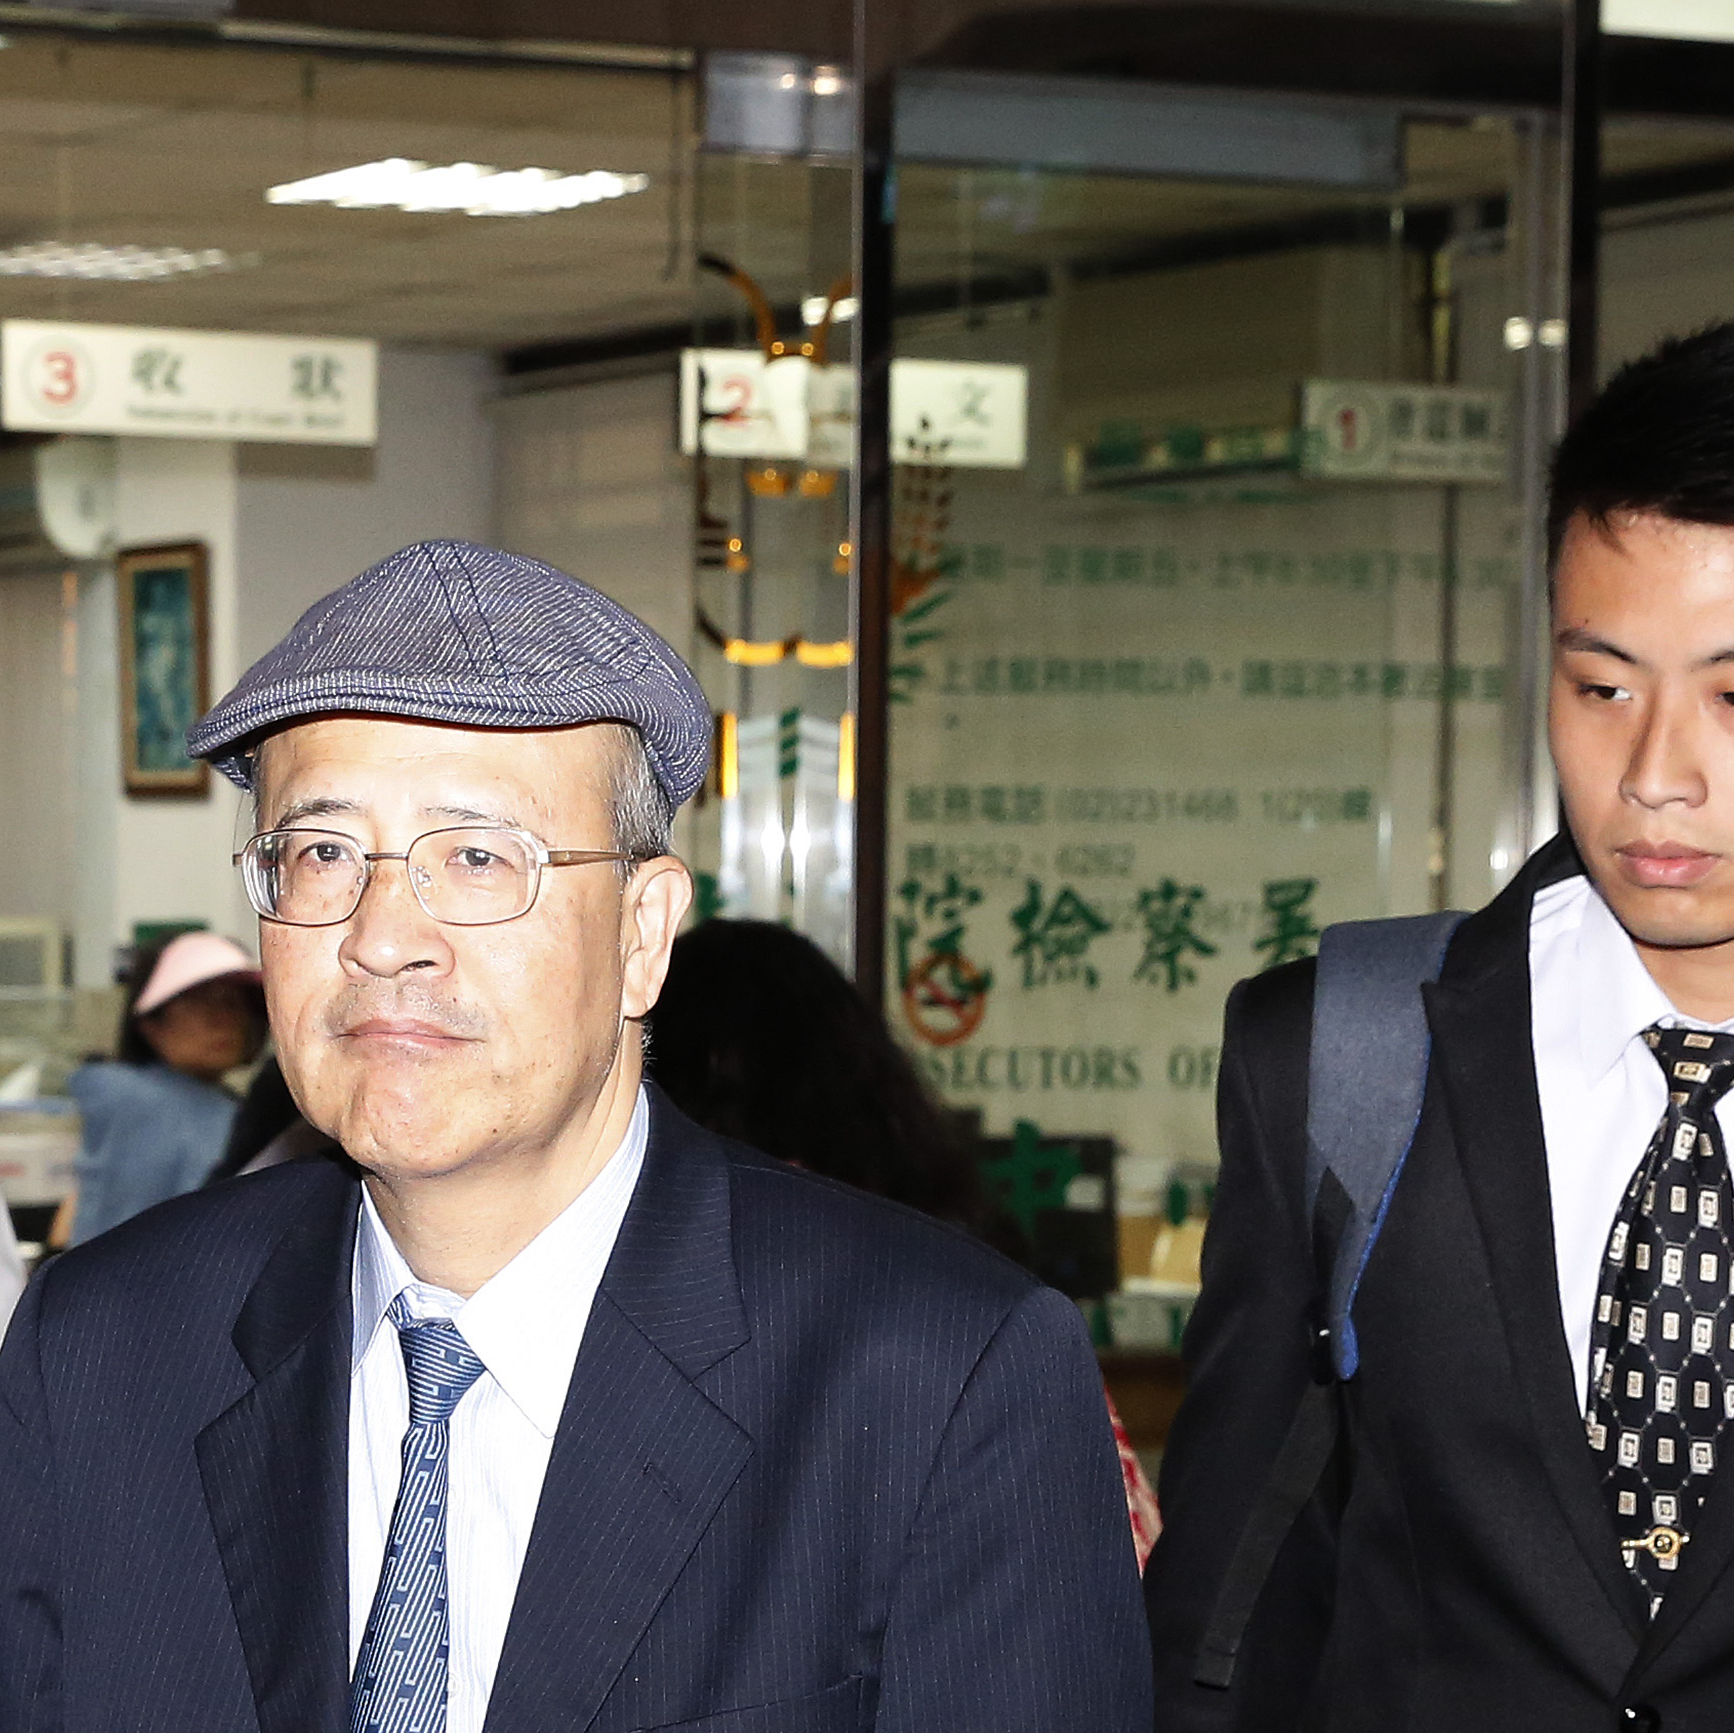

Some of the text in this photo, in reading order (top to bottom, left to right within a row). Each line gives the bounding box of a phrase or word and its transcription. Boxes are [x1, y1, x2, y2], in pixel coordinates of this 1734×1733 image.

[42, 350, 78, 404] 3
[721, 375, 753, 428] 2
[1338, 407, 1358, 450] 1
